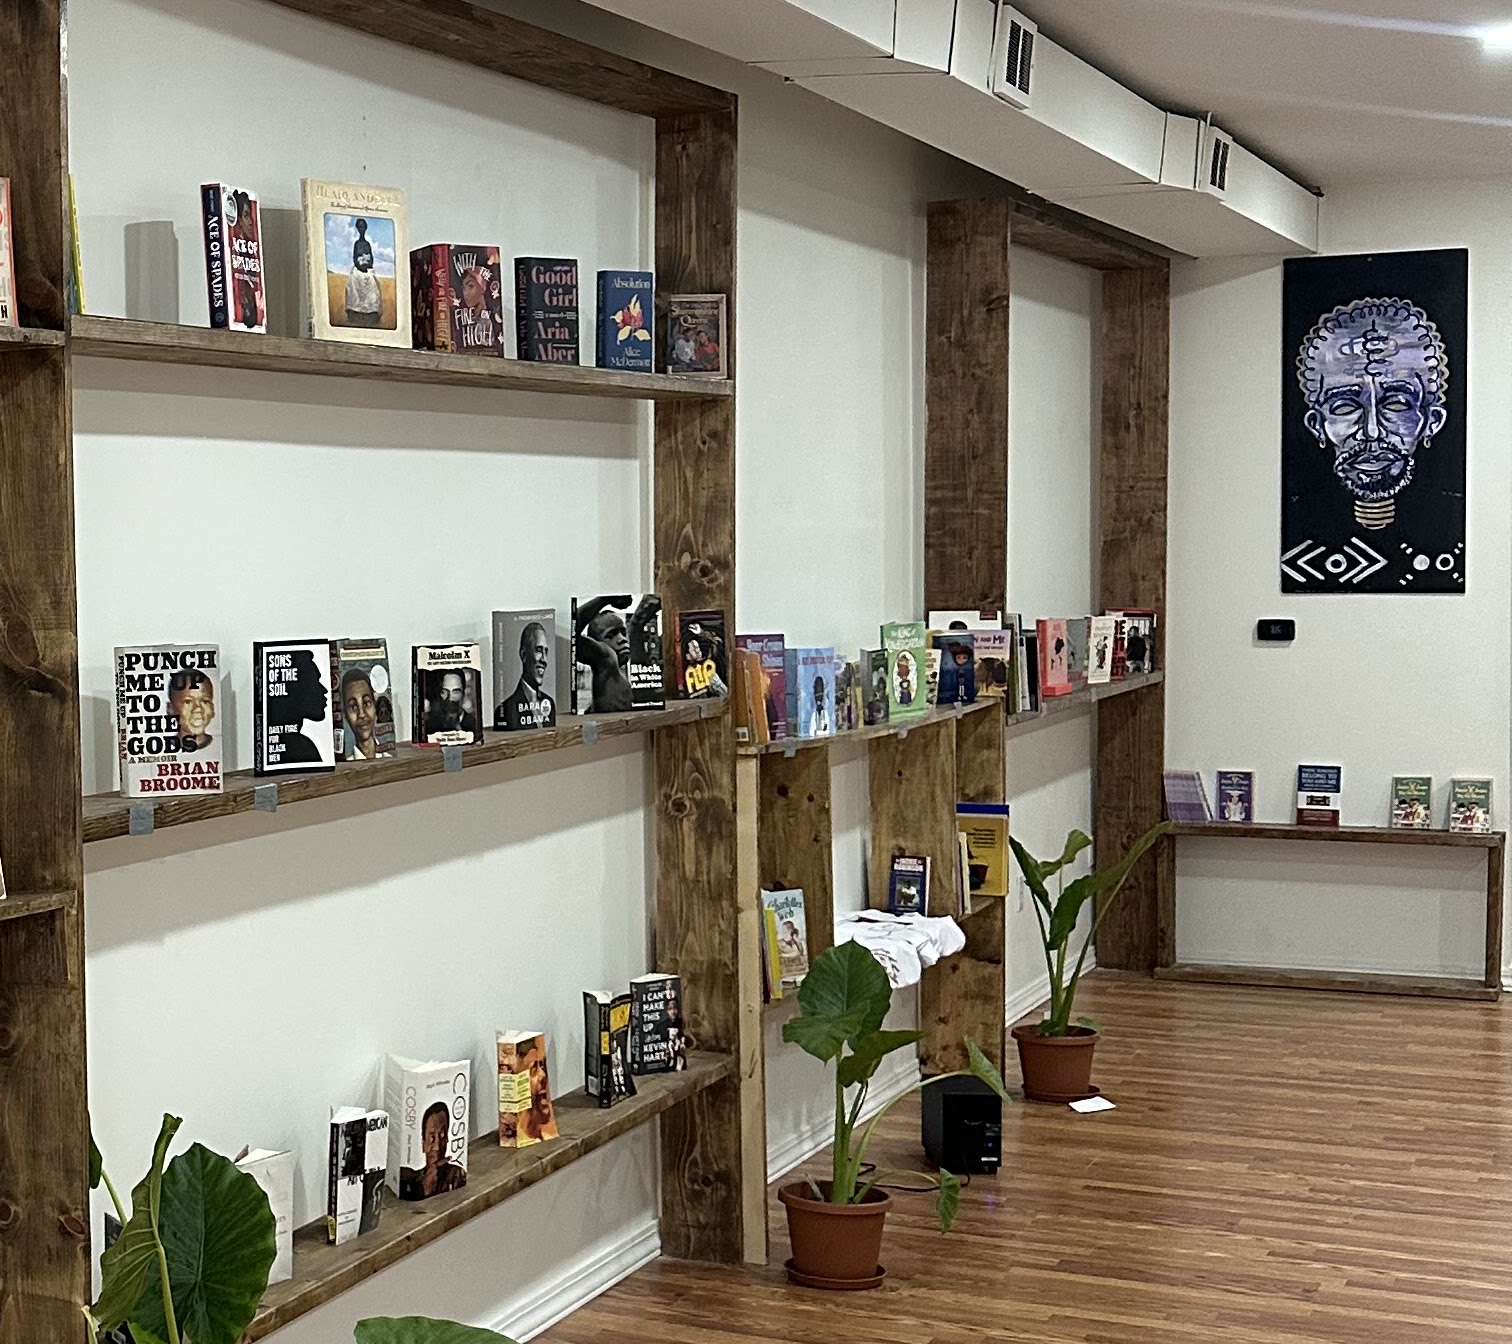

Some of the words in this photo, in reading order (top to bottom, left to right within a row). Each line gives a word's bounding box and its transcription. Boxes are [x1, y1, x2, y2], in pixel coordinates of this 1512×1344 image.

[207, 215, 220, 239] ACE
[210, 241, 220, 258] OF
[232, 254, 260, 273] SPADES
[453, 252, 477, 278] WITH
[531, 265, 577, 286] Good
[611, 277, 651, 289] Absolution
[211, 261, 224, 308] SPADES
[544, 287, 577, 307] Girl
[454, 306, 475, 331] FIRE
[462, 320, 494, 348] HIGH
[533, 321, 569, 340] Aria
[534, 343, 576, 362] Aber
[624, 347, 641, 357] Alice
[610, 356, 651, 367] McDermott
[125, 650, 217, 672] PUNCH
[269, 654, 292, 669] SONS
[428, 651, 462, 660] Malcolm
[464, 650, 471, 659] X
[269, 669, 280, 682] OF
[281, 667, 298, 682] THE
[630, 663, 661, 674] Black
[125, 673, 165, 692] ME
[170, 672, 203, 690] UP
[269, 683, 288, 697] SOIL
[631, 681, 663, 689] America
[126, 694, 161, 713] TO
[126, 714, 180, 735] THE
[520, 715, 550, 726] OBAMA
[127, 734, 198, 756] GODS
[269, 744, 286, 753] BLACK
[138, 755, 177, 764] MEMOIR
[157, 761, 219, 776] BRIAN
[139, 776, 220, 793] BROOME
[642, 1001, 665, 1012] MAKE
[643, 1012, 661, 1022] THIS
[643, 1022, 654, 1032] UP
[643, 1041, 667, 1053] KEVIN
[405, 1086, 417, 1131] COSBY
[451, 1072, 468, 1167] COSBY
